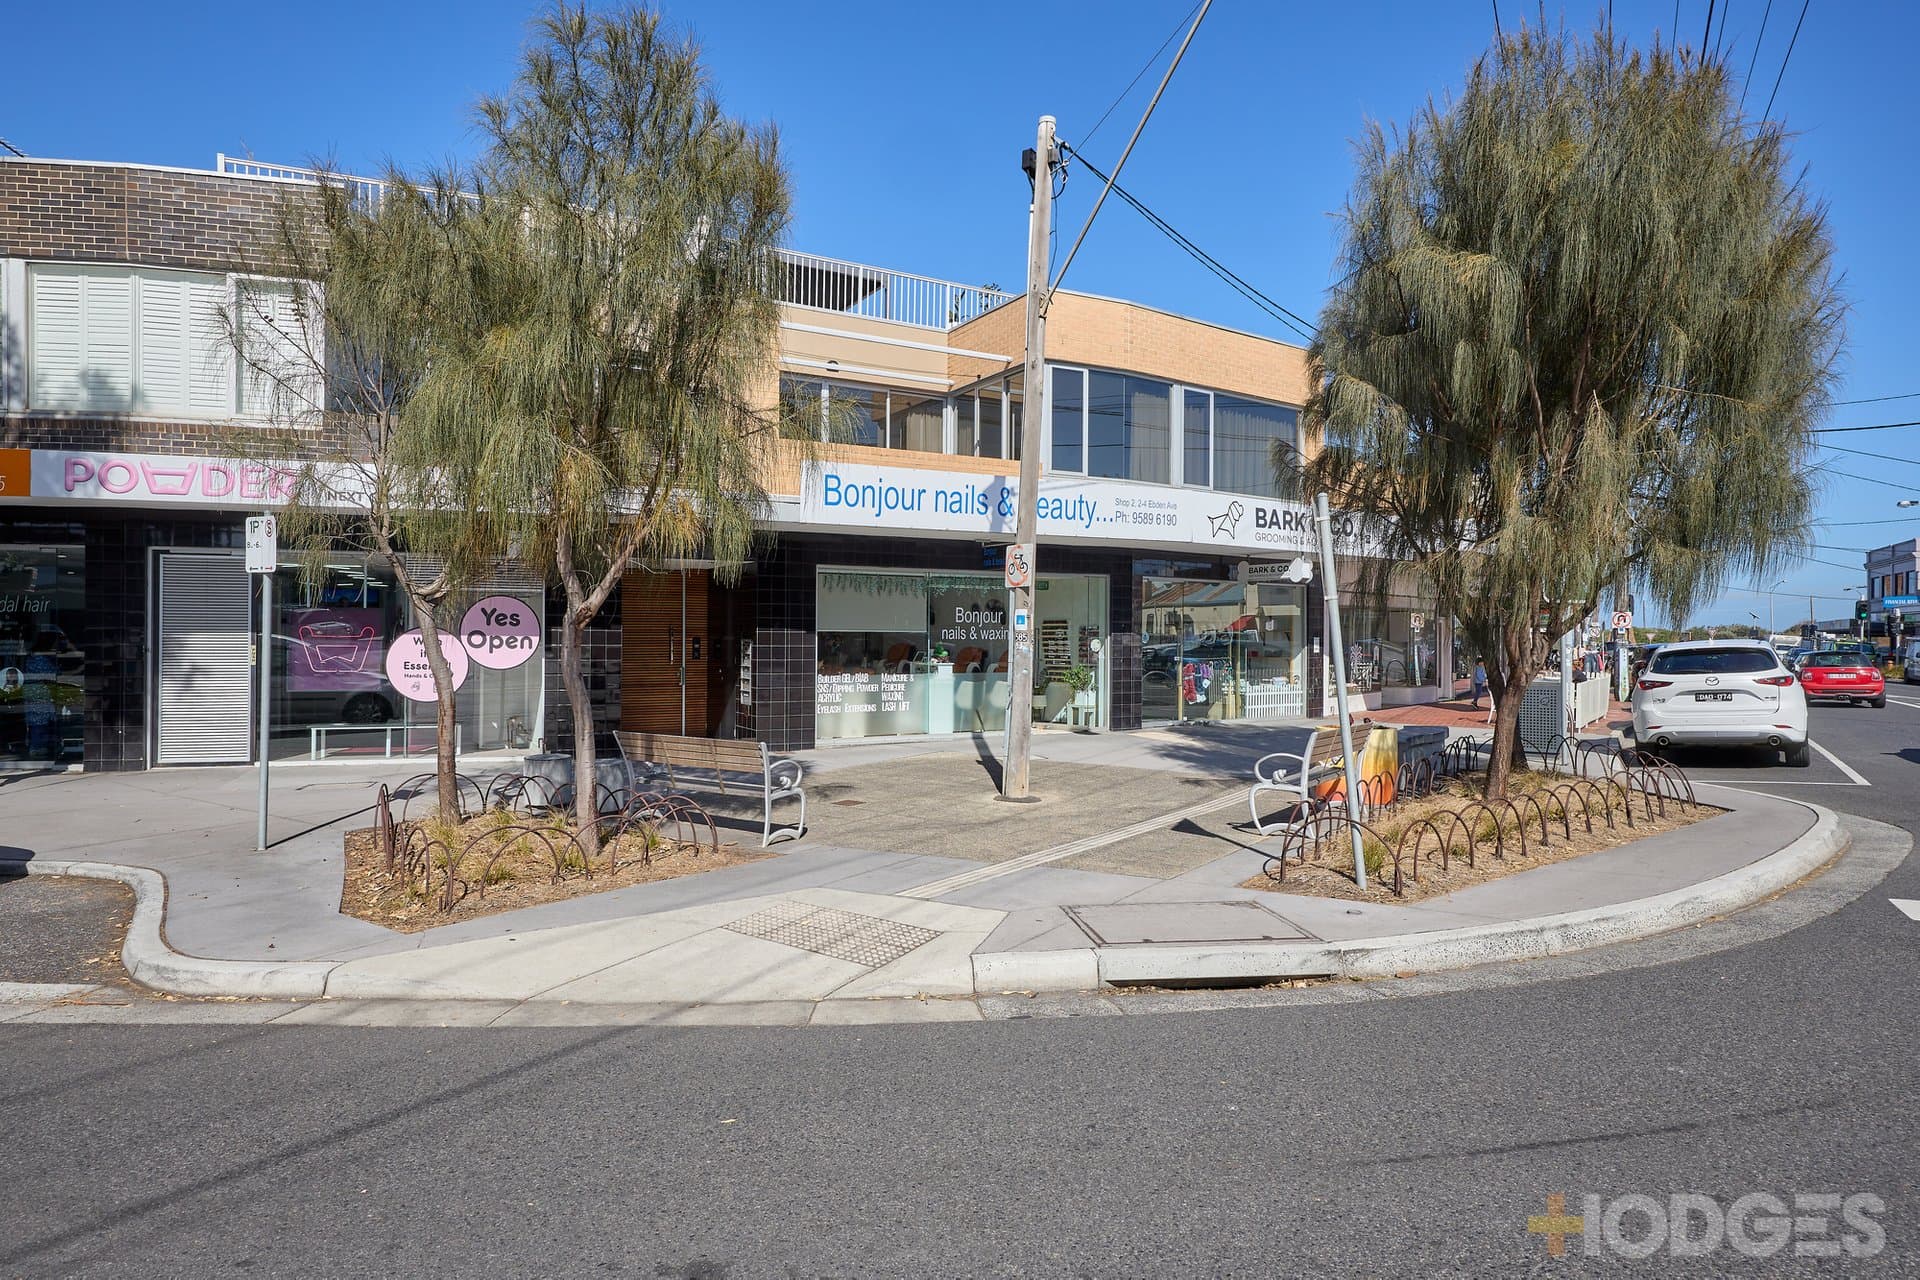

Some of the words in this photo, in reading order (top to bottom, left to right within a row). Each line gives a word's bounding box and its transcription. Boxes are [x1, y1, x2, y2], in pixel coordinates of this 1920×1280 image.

[65, 457, 298, 499] POWDER
[823, 473, 927, 518] Bonjour
[934, 484, 989, 516] nails
[996, 487, 1014, 516] &
[1036, 493, 1114, 529] eauty...
[1114, 497, 1130, 508] Shop
[1115, 510, 1130, 524] Ph:
[1132, 511, 1154, 525] 9589
[1156, 513, 1177, 527] 6190
[1255, 507, 1306, 533] BARK
[1255, 531, 1298, 545] GROOMING
[1248, 565, 1269, 575] BARK
[23, 594, 51, 613] hair
[481, 607, 521, 627] Yes
[955, 606, 1003, 628] Bonjour
[467, 629, 533, 654] Open
[941, 626, 967, 640] nails
[970, 626, 978, 640] &
[980, 626, 1009, 640] waxin
[881, 702, 897, 712] LASH
